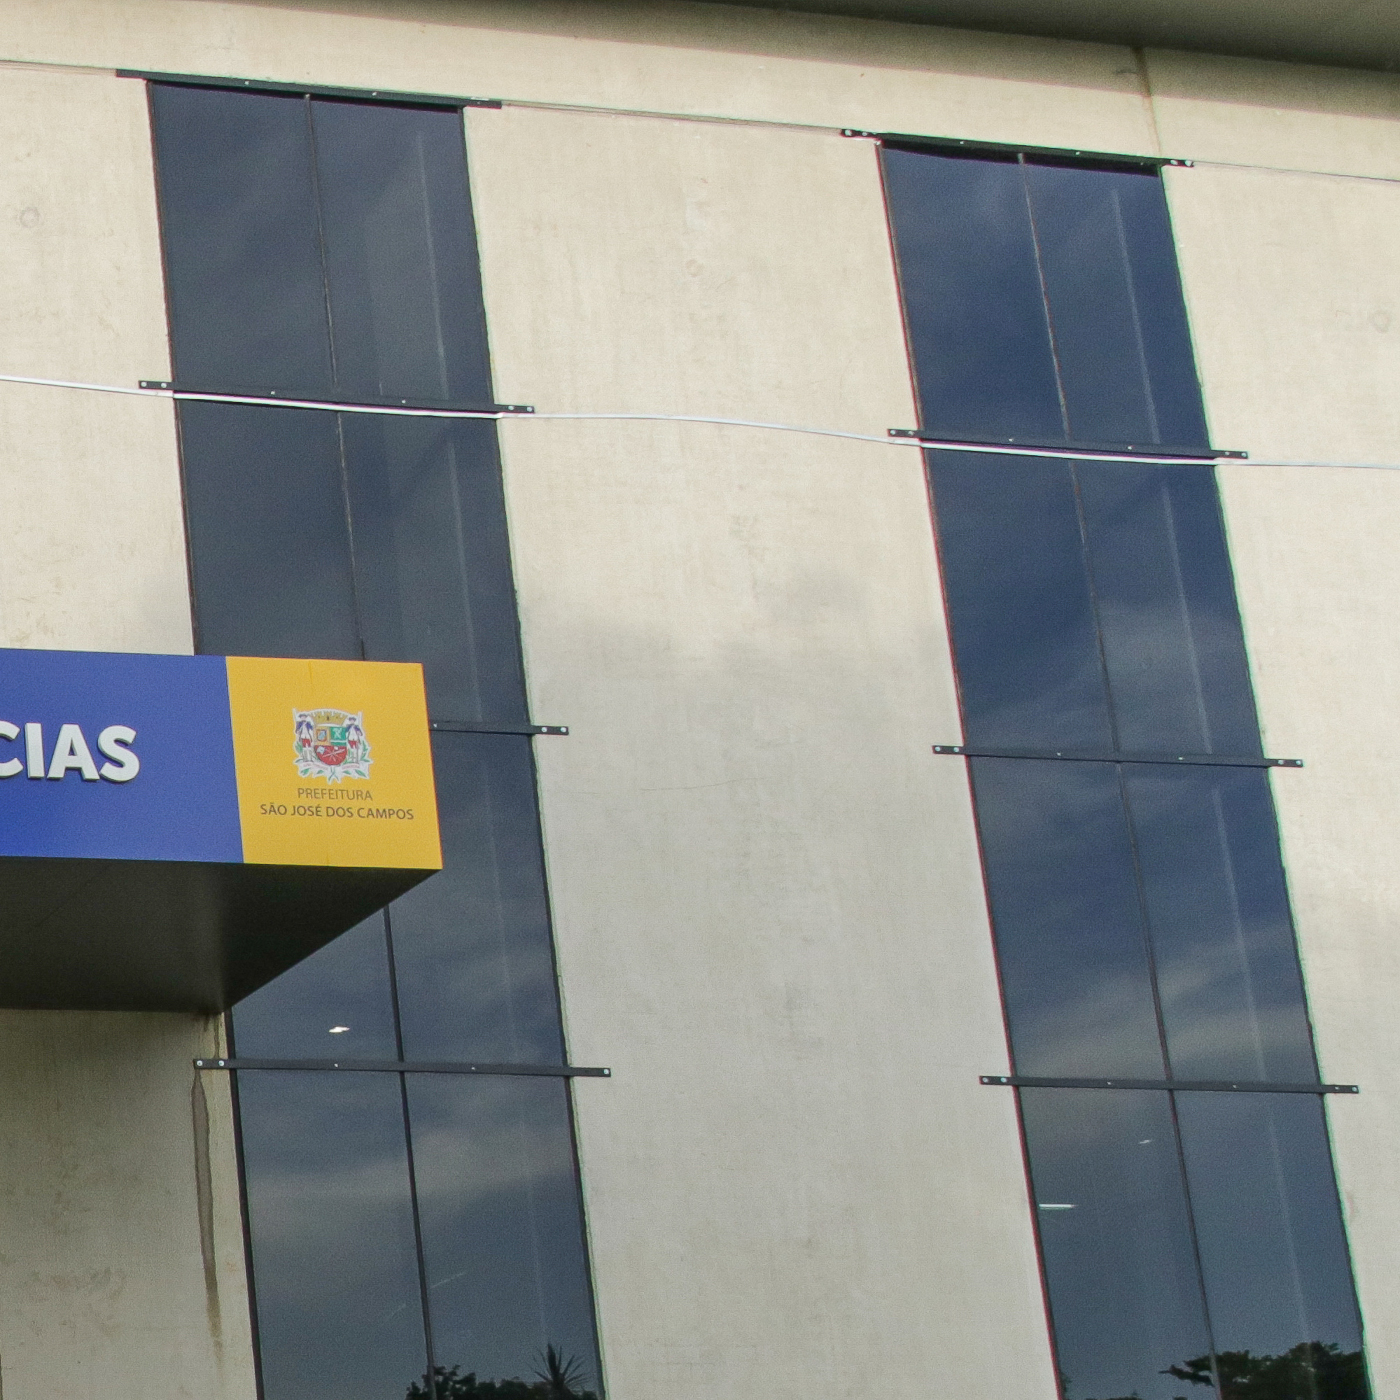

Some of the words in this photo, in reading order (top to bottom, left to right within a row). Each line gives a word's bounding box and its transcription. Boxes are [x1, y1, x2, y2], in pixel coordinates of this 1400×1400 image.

[297, 788, 373, 801] PREFEITURA
[260, 801, 287, 816] SÃO
[290, 803, 322, 817] JOSÉ
[326, 806, 354, 818] DOS
[357, 807, 414, 820] CAMPOS
